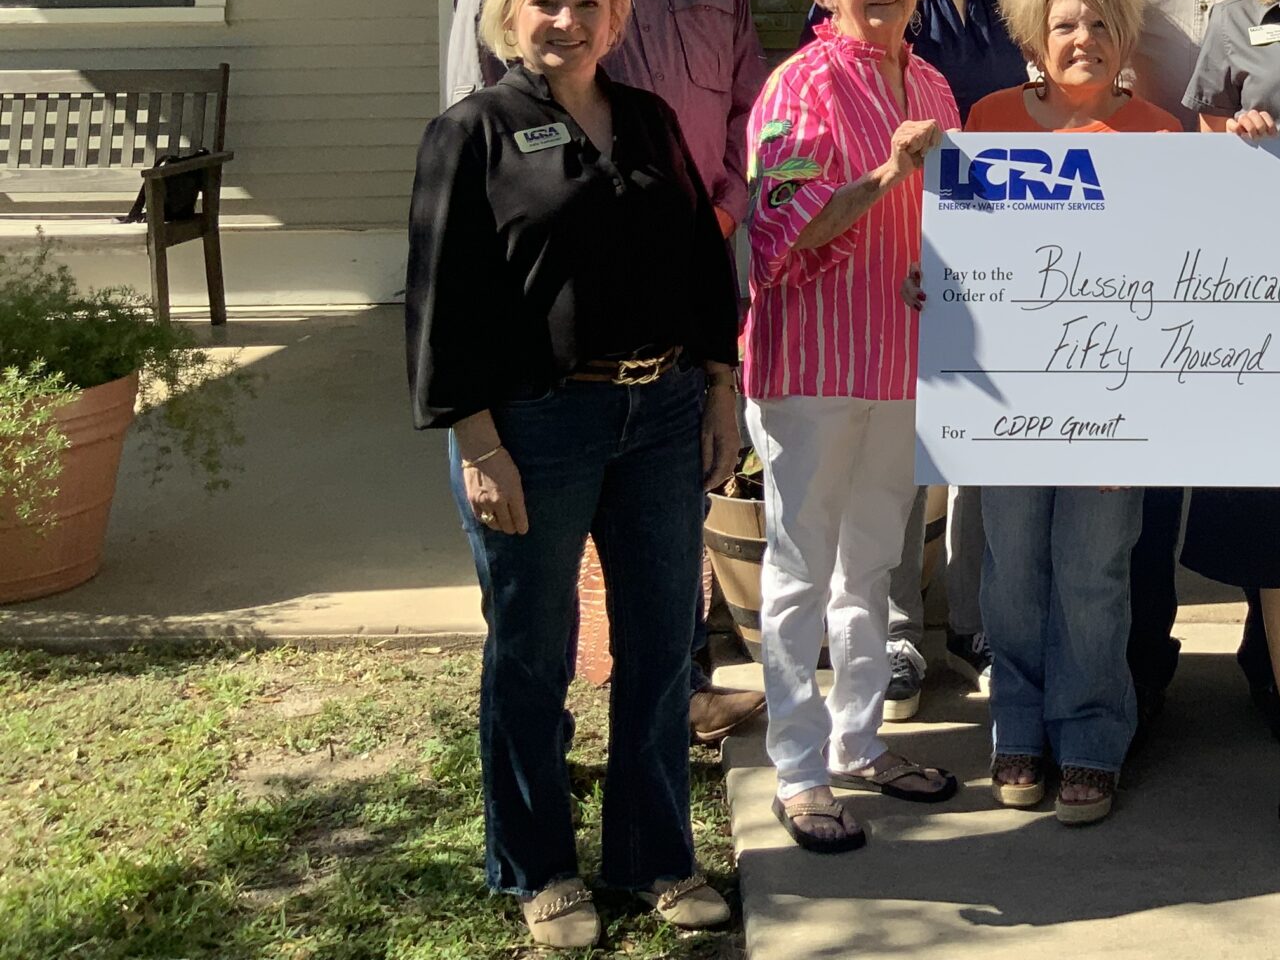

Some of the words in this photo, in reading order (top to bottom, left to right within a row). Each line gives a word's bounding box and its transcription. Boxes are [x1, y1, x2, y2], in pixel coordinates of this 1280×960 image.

[523, 126, 560, 143] LCRA
[939, 148, 1105, 201] LCRA
[938, 202, 971, 211] ENERGY
[977, 202, 1005, 211] WATER
[1012, 202, 1065, 211] COMMUNITY
[1068, 202, 1105, 211] SERVICES
[943, 268, 968, 284] Pay
[972, 269, 987, 281] to
[991, 268, 1013, 281] the
[1021, 245, 1155, 320] Blessing
[943, 289, 986, 302] Order
[989, 288, 1006, 302] of
[1046, 316, 1133, 390] Fifty
[1161, 320, 1272, 384] Thousand
[941, 426, 966, 439] For
[994, 416, 1053, 438] CDPP
[1061, 413, 1126, 443] Grant
